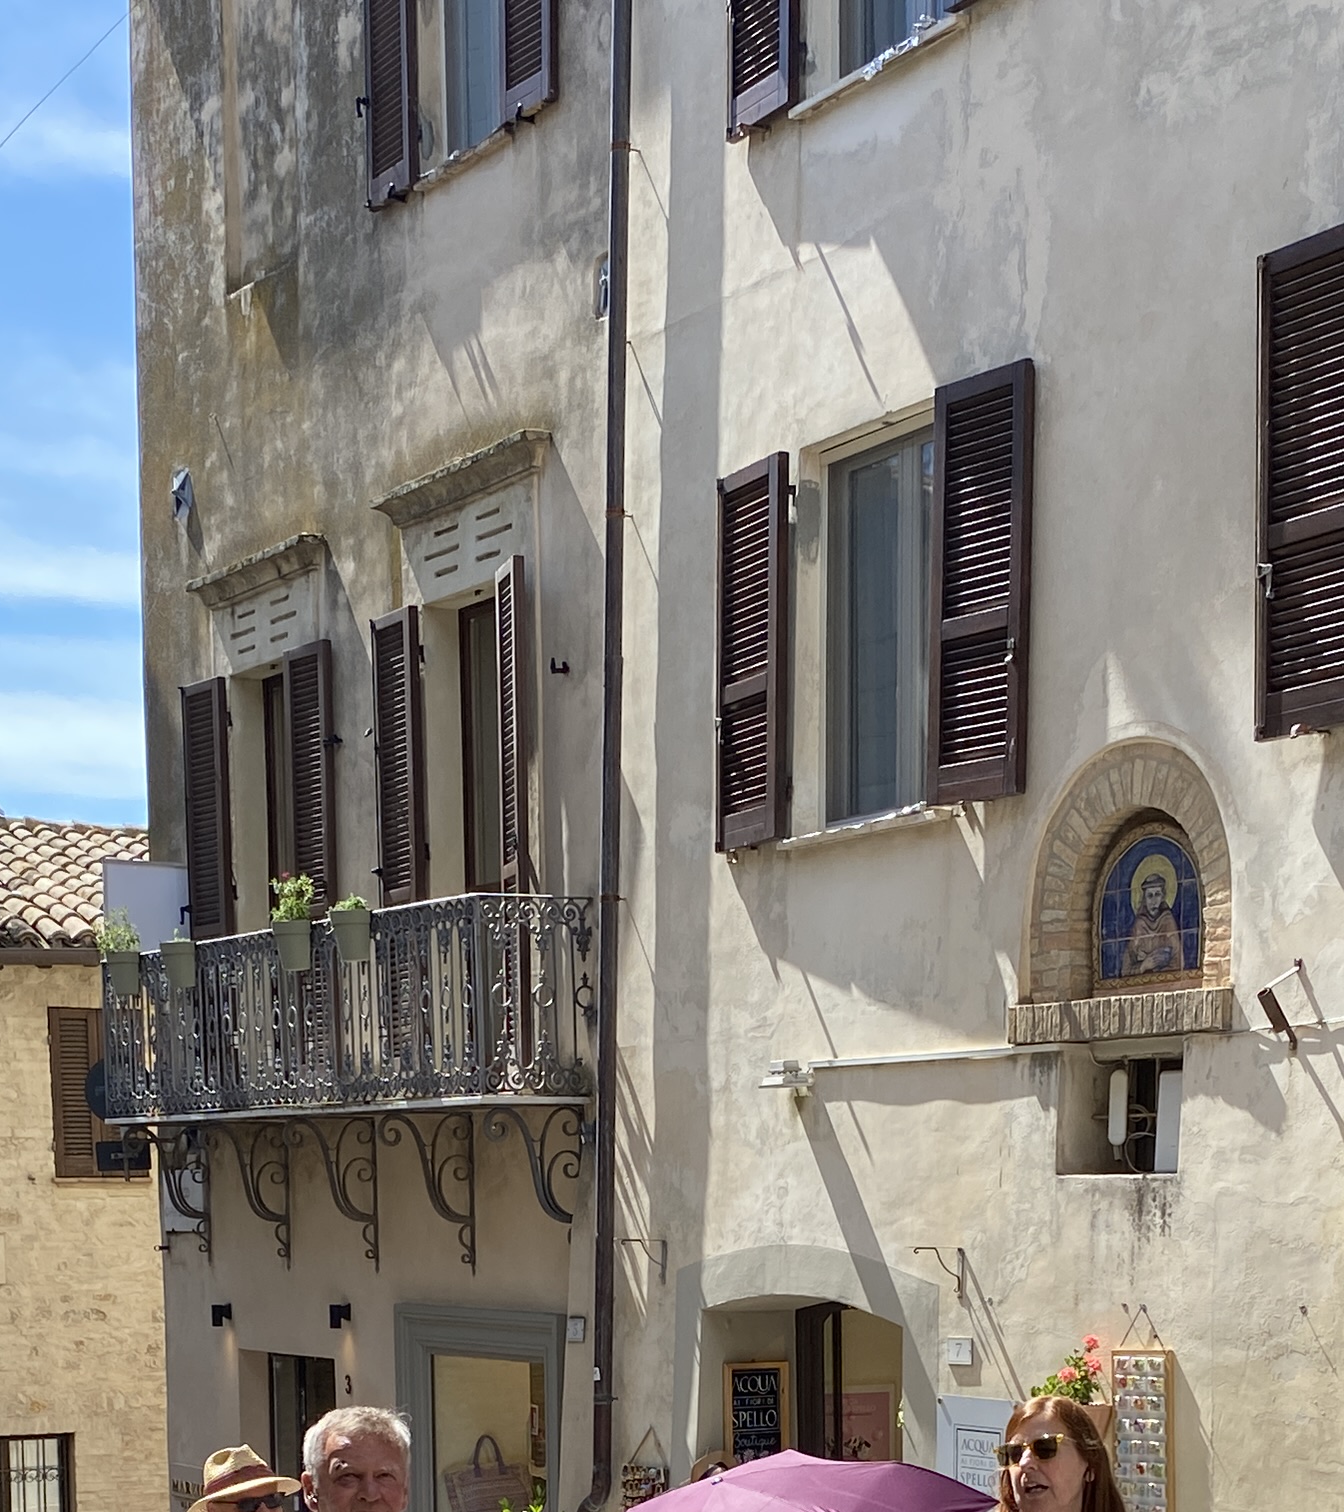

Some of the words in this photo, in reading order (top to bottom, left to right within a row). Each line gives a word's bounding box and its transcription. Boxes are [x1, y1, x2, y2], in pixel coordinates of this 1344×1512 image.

[955, 1342, 963, 1358] 7
[345, 1374, 352, 1395] 3
[733, 1374, 777, 1395] ACQUA
[732, 1409, 777, 1428] SPELLO
[734, 1432, 776, 1452] Boutique
[961, 1438, 994, 1456] ACQUA
[960, 1471, 996, 1488] SPELLO
